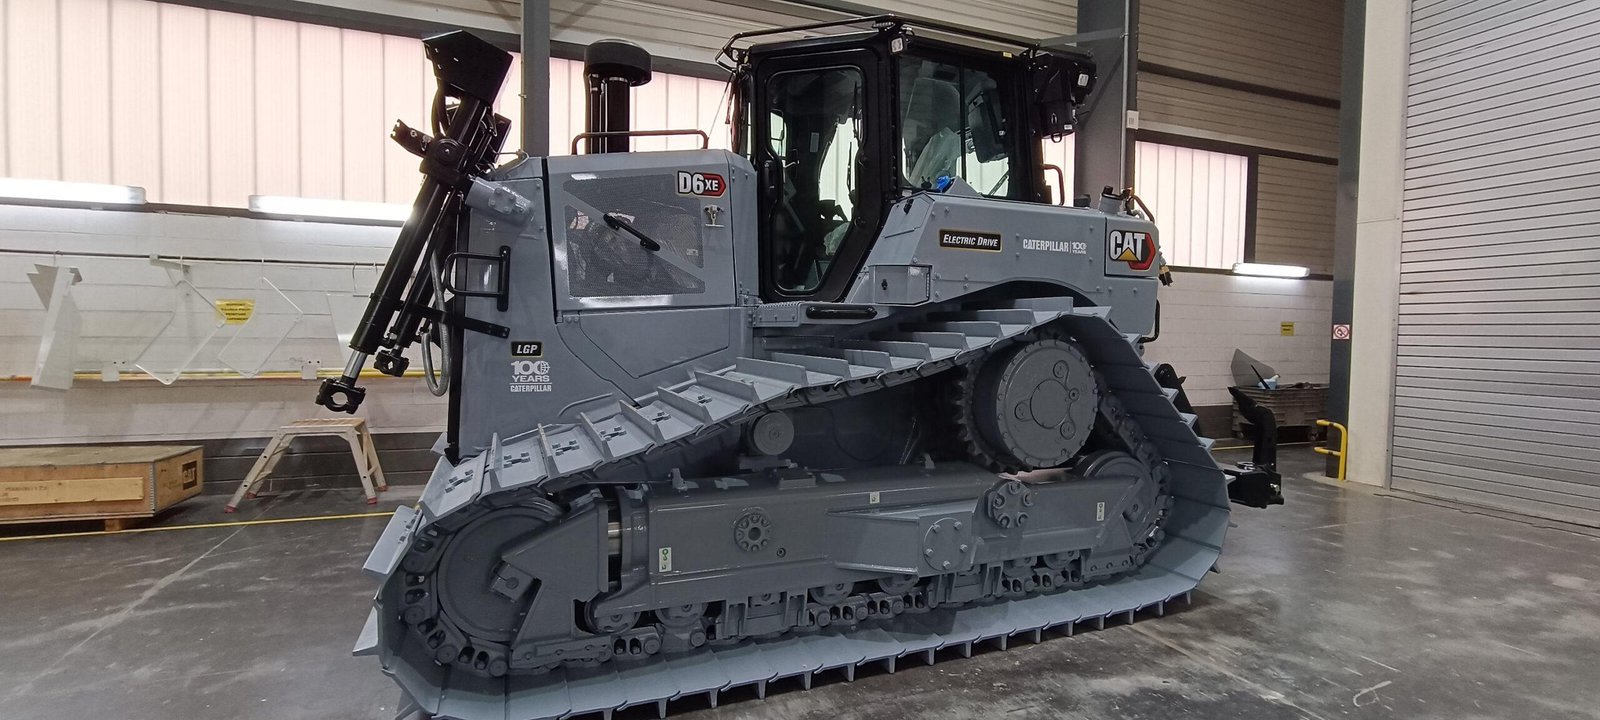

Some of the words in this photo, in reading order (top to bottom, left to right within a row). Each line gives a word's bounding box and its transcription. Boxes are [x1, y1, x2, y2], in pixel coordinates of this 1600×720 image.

[943, 233, 976, 246] ELECTRIC
[976, 236, 999, 247] DRIVE
[1022, 238, 1069, 253] CATERPILLAR
[1110, 230, 1146, 261] CAT
[516, 344, 538, 354] LGP
[510, 360, 551, 375] 100
[510, 384, 552, 392] CATERPILLAR
